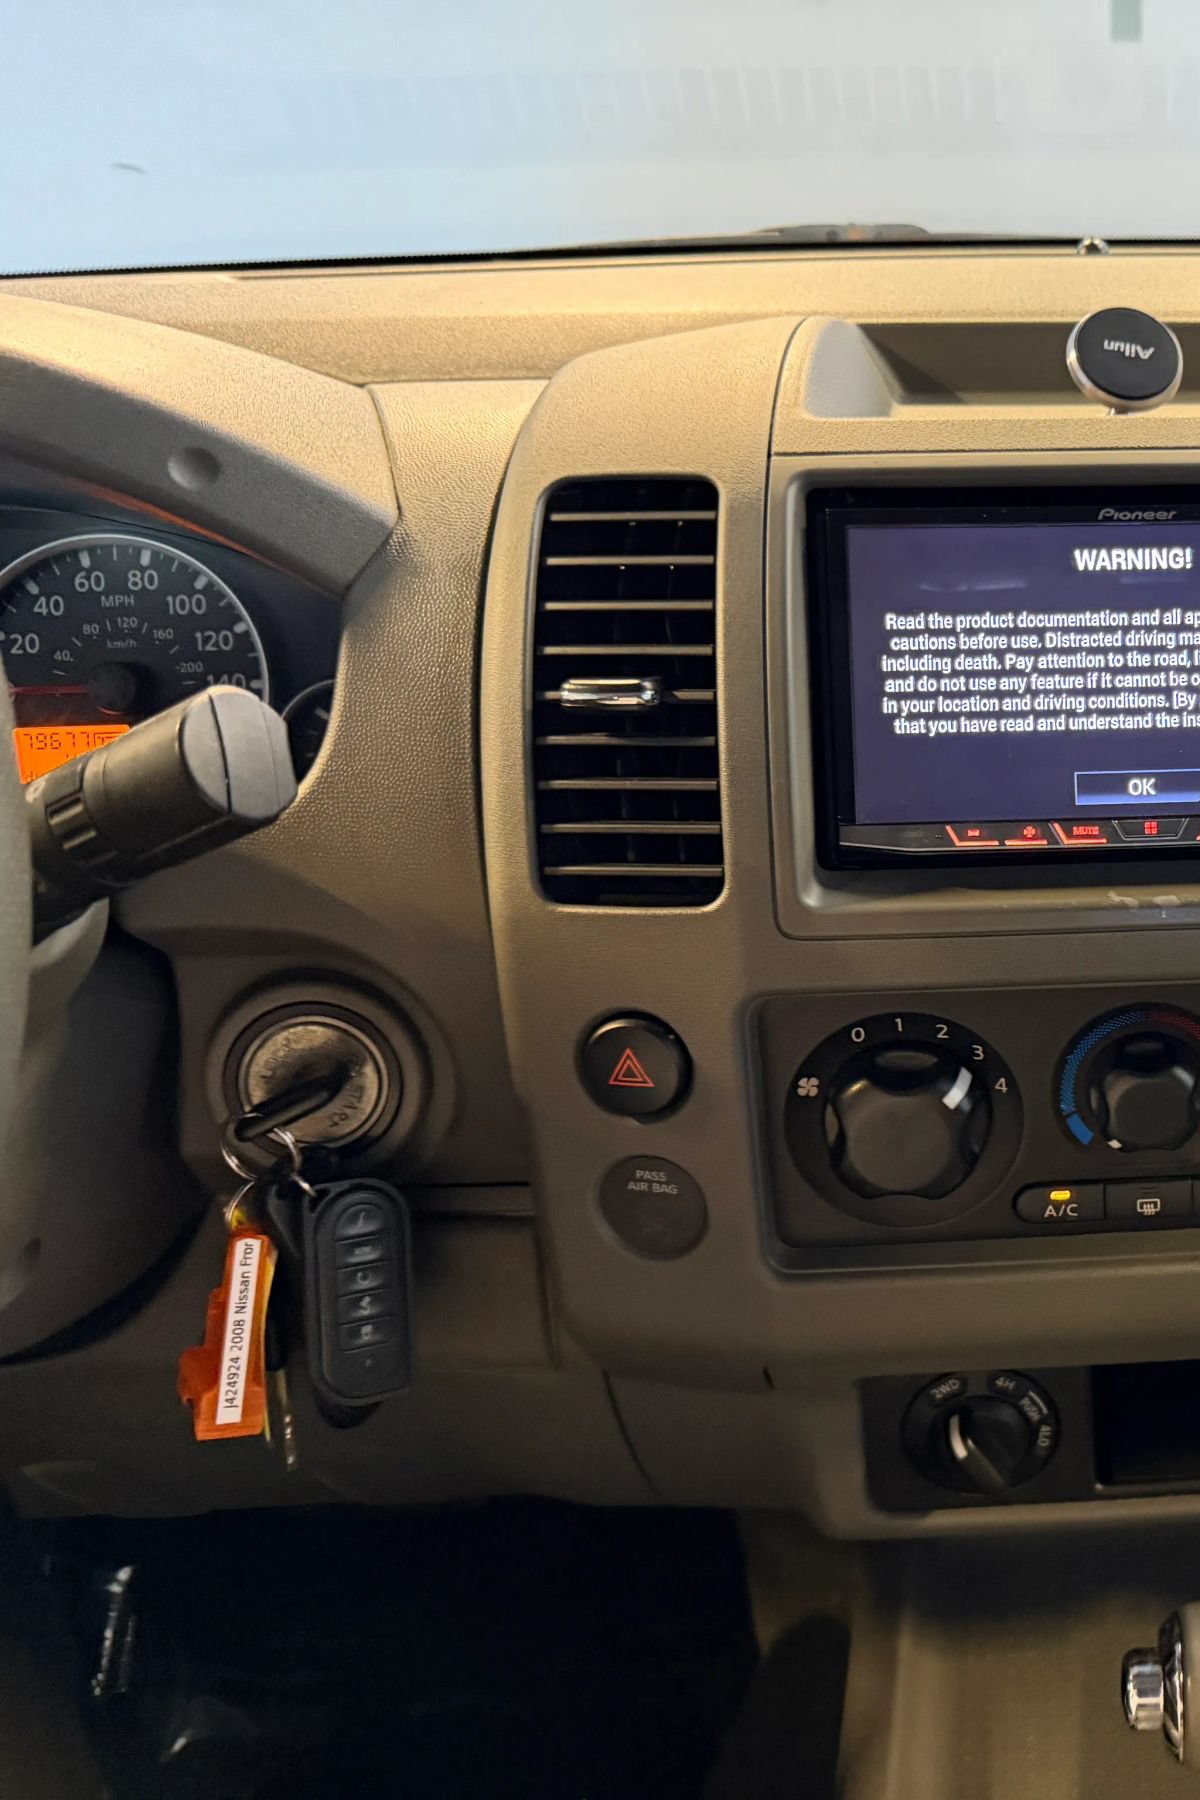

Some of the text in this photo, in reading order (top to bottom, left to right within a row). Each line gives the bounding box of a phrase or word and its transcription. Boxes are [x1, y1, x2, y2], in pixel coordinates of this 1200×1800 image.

[1098, 508, 1177, 521] Pioneer
[1074, 548, 1193, 571] WARNING!
[74, 571, 105, 592] 60
[127, 570, 158, 591] 80
[33, 595, 64, 616] 40
[101, 596, 134, 608] MPH
[166, 595, 206, 615] 100
[117, 617, 138, 628] 120
[885, 613, 924, 630] Read
[928, 612, 952, 629] the
[956, 611, 1014, 632] product
[1016, 609, 1128, 627] documentation
[1132, 608, 1159, 625] and
[1163, 608, 1181, 624] all
[83, 624, 99, 634] 80
[153, 629, 174, 639] 160
[10, 634, 40, 654] 20
[107, 639, 137, 649] km/h
[195, 631, 233, 651] 120
[890, 632, 955, 649] cautions
[960, 631, 1007, 648] before
[1011, 634, 1041, 647] use.
[1045, 629, 1122, 647] Distracted
[1126, 628, 1175, 649] driving
[54, 650, 71, 661] 40
[881, 654, 951, 675] including
[954, 653, 1001, 670] death.
[1005, 653, 1034, 673] Pay
[1037, 651, 1104, 668] attention
[1108, 651, 1124, 667] to
[1126, 651, 1151, 667] the
[1154, 650, 1191, 670] road,
[884, 676, 914, 692] and
[918, 675, 937, 691] do
[940, 675, 966, 691] not
[969, 678, 997, 691] use
[1000, 677, 1027, 694] any
[1031, 673, 1084, 689] feature
[1086, 673, 1098, 689] if
[1102, 672, 1112, 688] it
[1114, 671, 1166, 688] cannot
[1169, 671, 1188, 687] be
[882, 697, 897, 713] in
[900, 699, 936, 717] your
[938, 695, 998, 712] location
[1002, 694, 1030, 711] and
[1034, 693, 1085, 714] driving
[1089, 691, 1170, 709] conditions.
[1172, 691, 1196, 711] [By
[894, 717, 925, 733] that
[928, 720, 956, 737] you
[960, 716, 996, 732] have
[1000, 715, 1033, 731] read
[1037, 714, 1065, 731] and
[1068, 713, 1152, 730] understand
[1156, 712, 1180, 729] the
[1128, 779, 1156, 796] OK
[1073, 826, 1099, 836] MUTE
[895, 1018, 903, 1032] 1
[935, 1024, 949, 1039] 2
[851, 1027, 865, 1043] 0
[971, 1045, 984, 1061] 3
[994, 1078, 1008, 1093] 4
[635, 1170, 667, 1182] PASS
[627, 1181, 681, 1195] AIR BAG
[1044, 1203, 1079, 1218] A/C
[234, 1271, 251, 1315] Nissan
[230, 1318, 245, 1351] 2008
[930, 1378, 961, 1399] 2WD
[995, 1376, 1016, 1390] 4H
[1018, 1396, 1041, 1423] PUSH
